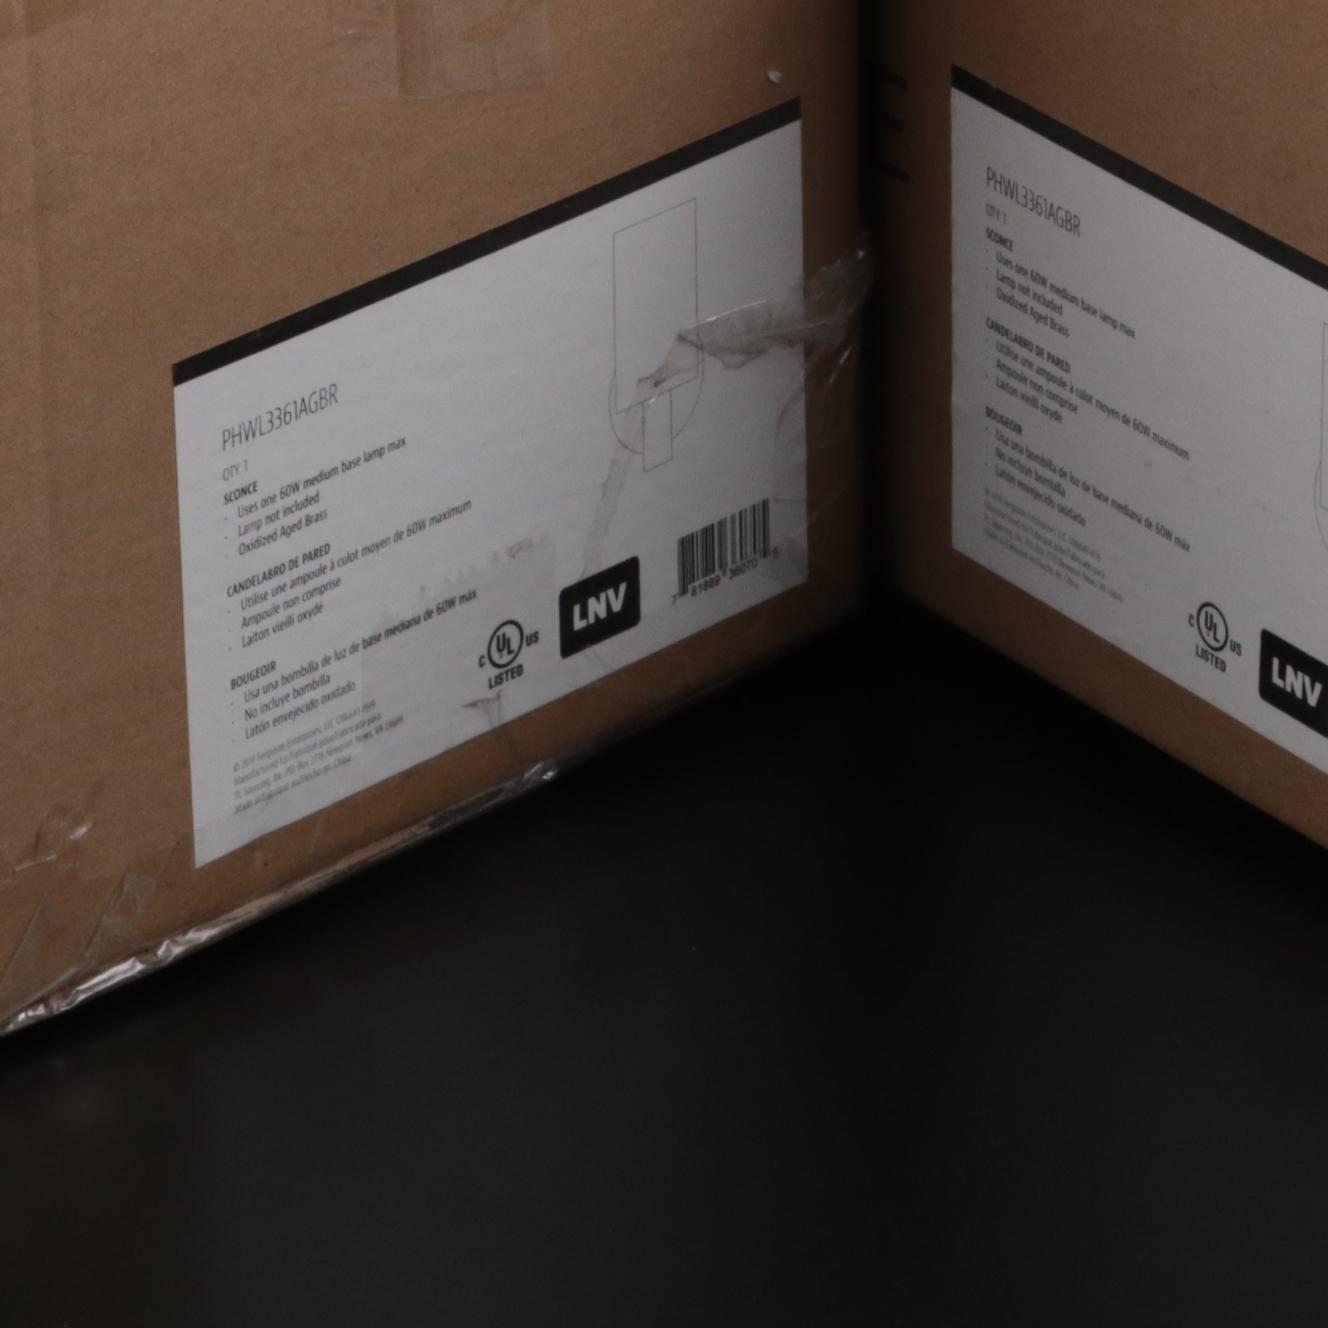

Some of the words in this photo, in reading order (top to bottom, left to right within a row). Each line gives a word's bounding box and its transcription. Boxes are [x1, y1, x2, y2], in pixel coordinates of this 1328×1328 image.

[985, 166, 1080, 235] PHWL3361AGBR
[222, 383, 338, 450] PHWL3361AGBR
[224, 481, 257, 504] SCONCE
[237, 501, 259, 518] Uses
[260, 493, 277, 509] one
[279, 481, 300, 500] 60W
[302, 466, 339, 489] medium
[341, 456, 362, 473] base
[363, 446, 386, 463] lamp
[387, 437, 406, 452] max
[238, 518, 263, 537] Lamp
[264, 509, 280, 525] not
[282, 490, 320, 517] included
[238, 529, 278, 556] Oxidized
[279, 517, 303, 538] Aged
[304, 510, 328, 528] Brass
[227, 563, 286, 597] CANDELABRO
[288, 556, 299, 571] DE
[302, 543, 331, 564] PARED
[240, 591, 269, 611] Utilise
[271, 582, 288, 597] une
[289, 564, 328, 589] ampoule
[336, 549, 359, 568] culot
[361, 536, 391, 557] moyen
[392, 530, 405, 543] de
[406, 519, 426, 537] 60W
[429, 500, 472, 526] maximum
[242, 604, 280, 628] Ampoule
[283, 596, 299, 610] non
[302, 577, 341, 602] comprise
[573, 583, 626, 631] LNV
[241, 627, 270, 648] Laiton
[271, 614, 295, 634] vieilli
[244, 688, 261, 703] Usa
[262, 680, 279, 695] una
[280, 661, 320, 686] bombilla
[320, 655, 332, 668] de
[333, 648, 347, 661] luz
[348, 642, 360, 655] de
[362, 632, 383, 650] base
[383, 615, 422, 638] mediana
[422, 608, 434, 622] de
[435, 597, 457, 616] 60W
[495, 632, 515, 658] UL
[525, 631, 539, 647] US
[1204, 610, 1220, 644] UL
[1229, 639, 1242, 656] US
[230, 660, 276, 690] BOUGEOIR
[488, 664, 524, 689] LISTED
[1195, 645, 1227, 673] LISTED
[1272, 657, 1322, 707] LNV
[244, 708, 258, 720] No
[260, 692, 290, 715] incluye
[292, 674, 331, 699] bombilla
[272, 698, 320, 727] envejecido
[320, 681, 356, 705] oxidado
